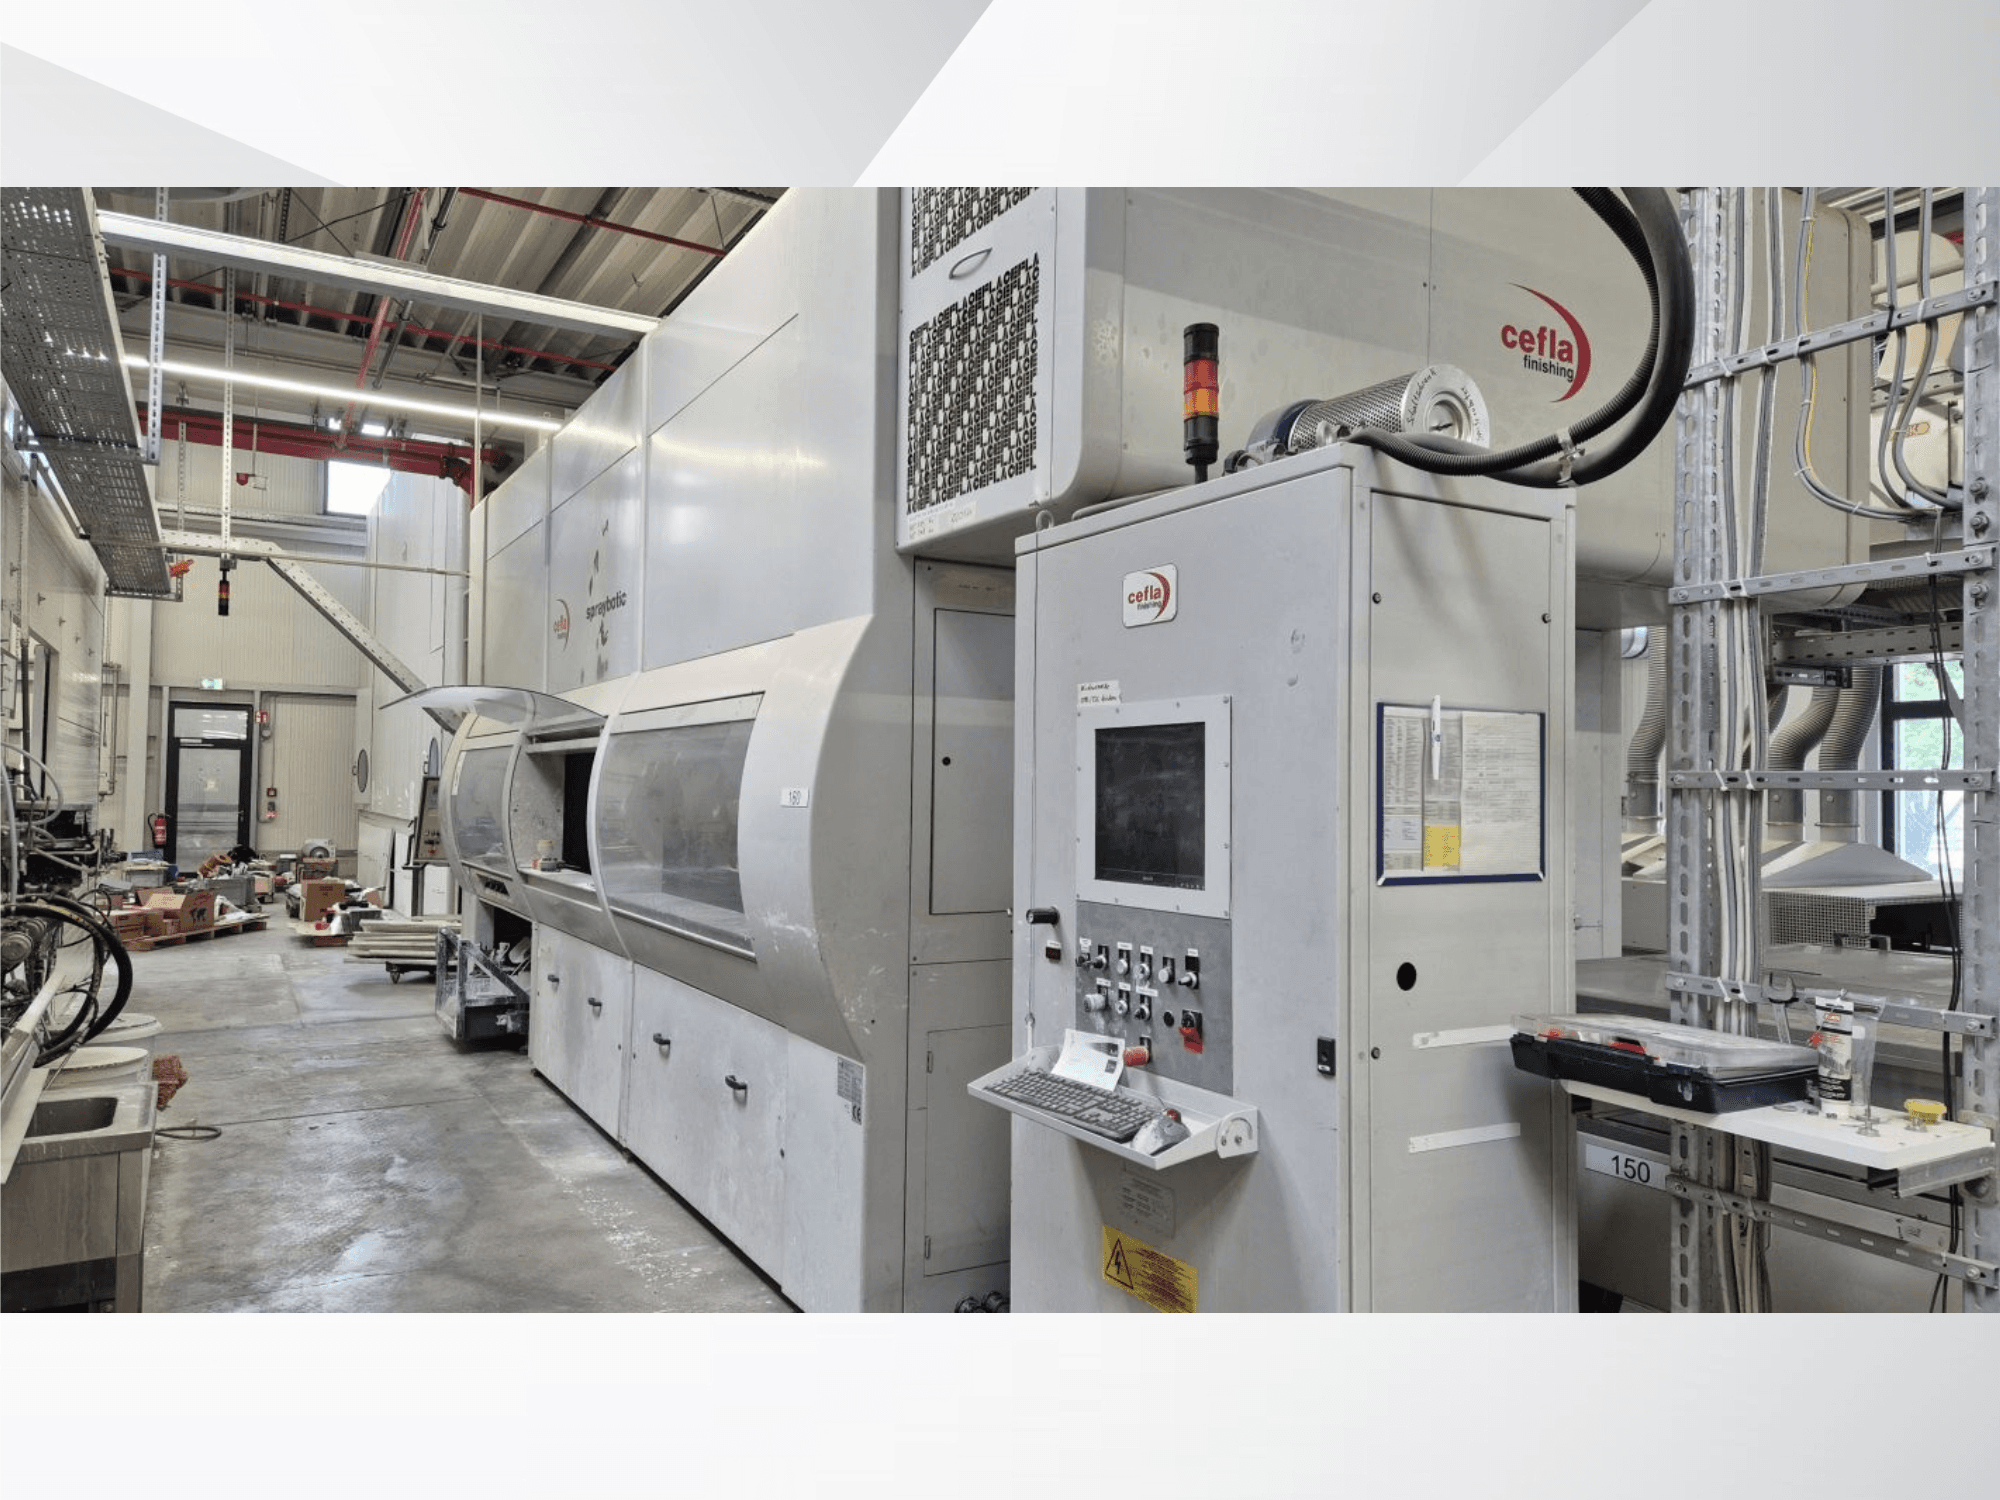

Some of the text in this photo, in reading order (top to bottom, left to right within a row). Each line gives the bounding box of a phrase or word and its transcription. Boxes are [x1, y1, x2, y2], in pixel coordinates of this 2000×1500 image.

[1501, 324, 1574, 363] cefla
[1523, 355, 1575, 382] finishing
[586, 590, 627, 622] spraybotic
[1128, 585, 1162, 604] cefla
[1611, 1154, 1651, 1184] 150
